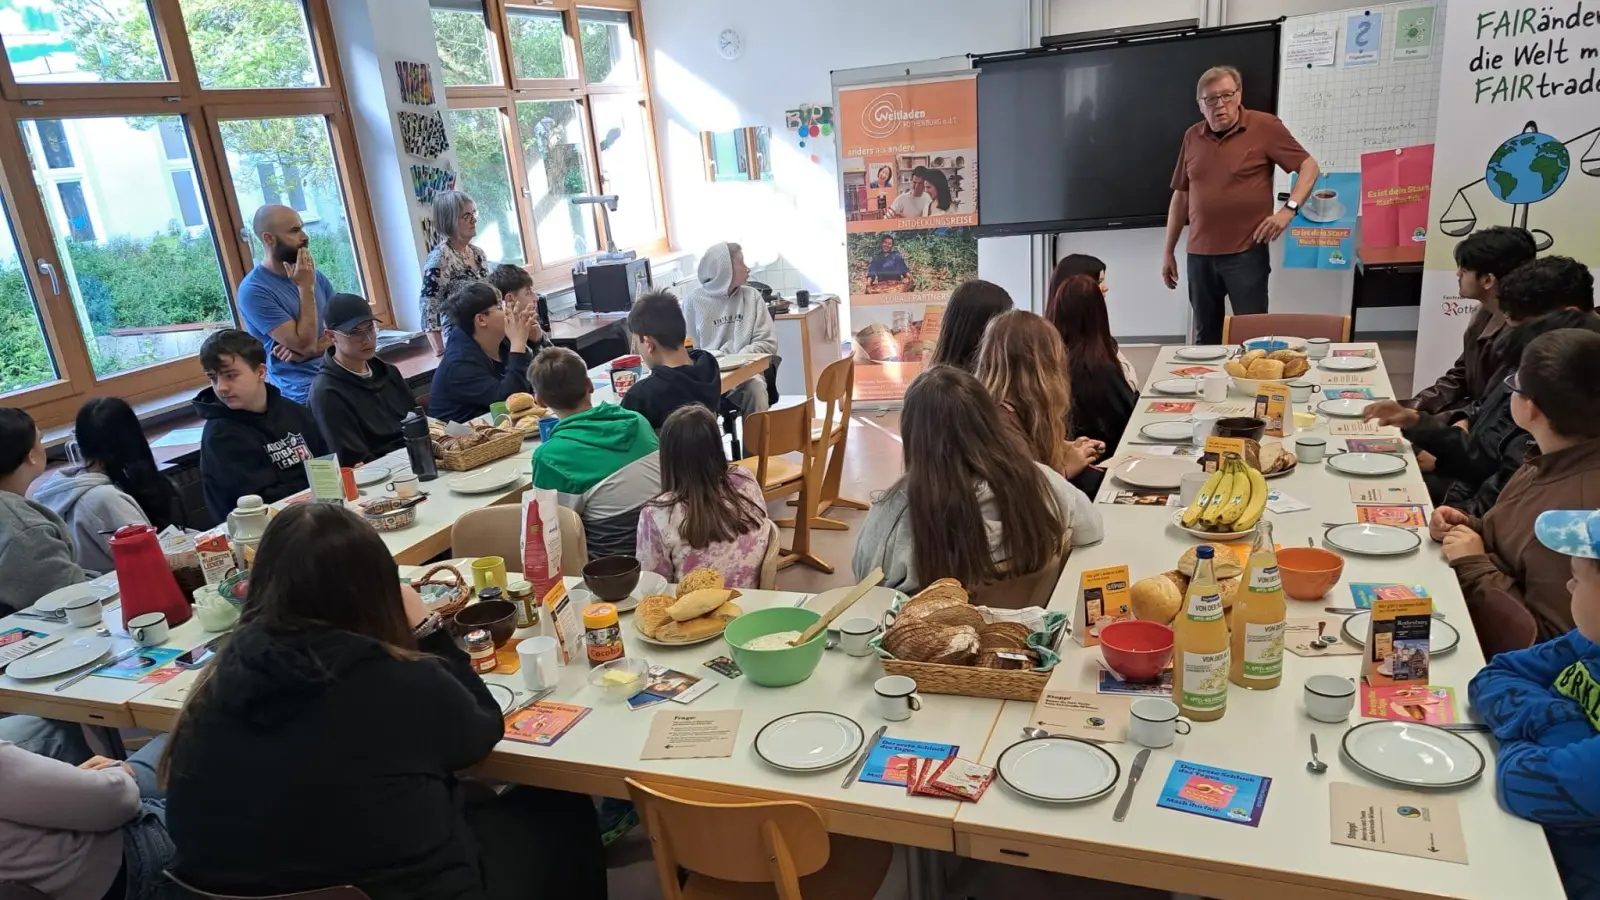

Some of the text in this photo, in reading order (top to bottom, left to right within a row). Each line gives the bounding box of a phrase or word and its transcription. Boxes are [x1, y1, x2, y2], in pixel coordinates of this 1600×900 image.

[1469, 46, 1503, 72] die
[1514, 38, 1569, 67] Welt
[847, 146, 873, 156] anders
[888, 144, 915, 154] andere
[916, 744, 946, 752] Schluck
[1197, 767, 1220, 775] erste
[1220, 771, 1255, 783] Schluck
[1166, 797, 1188, 807] Mach
